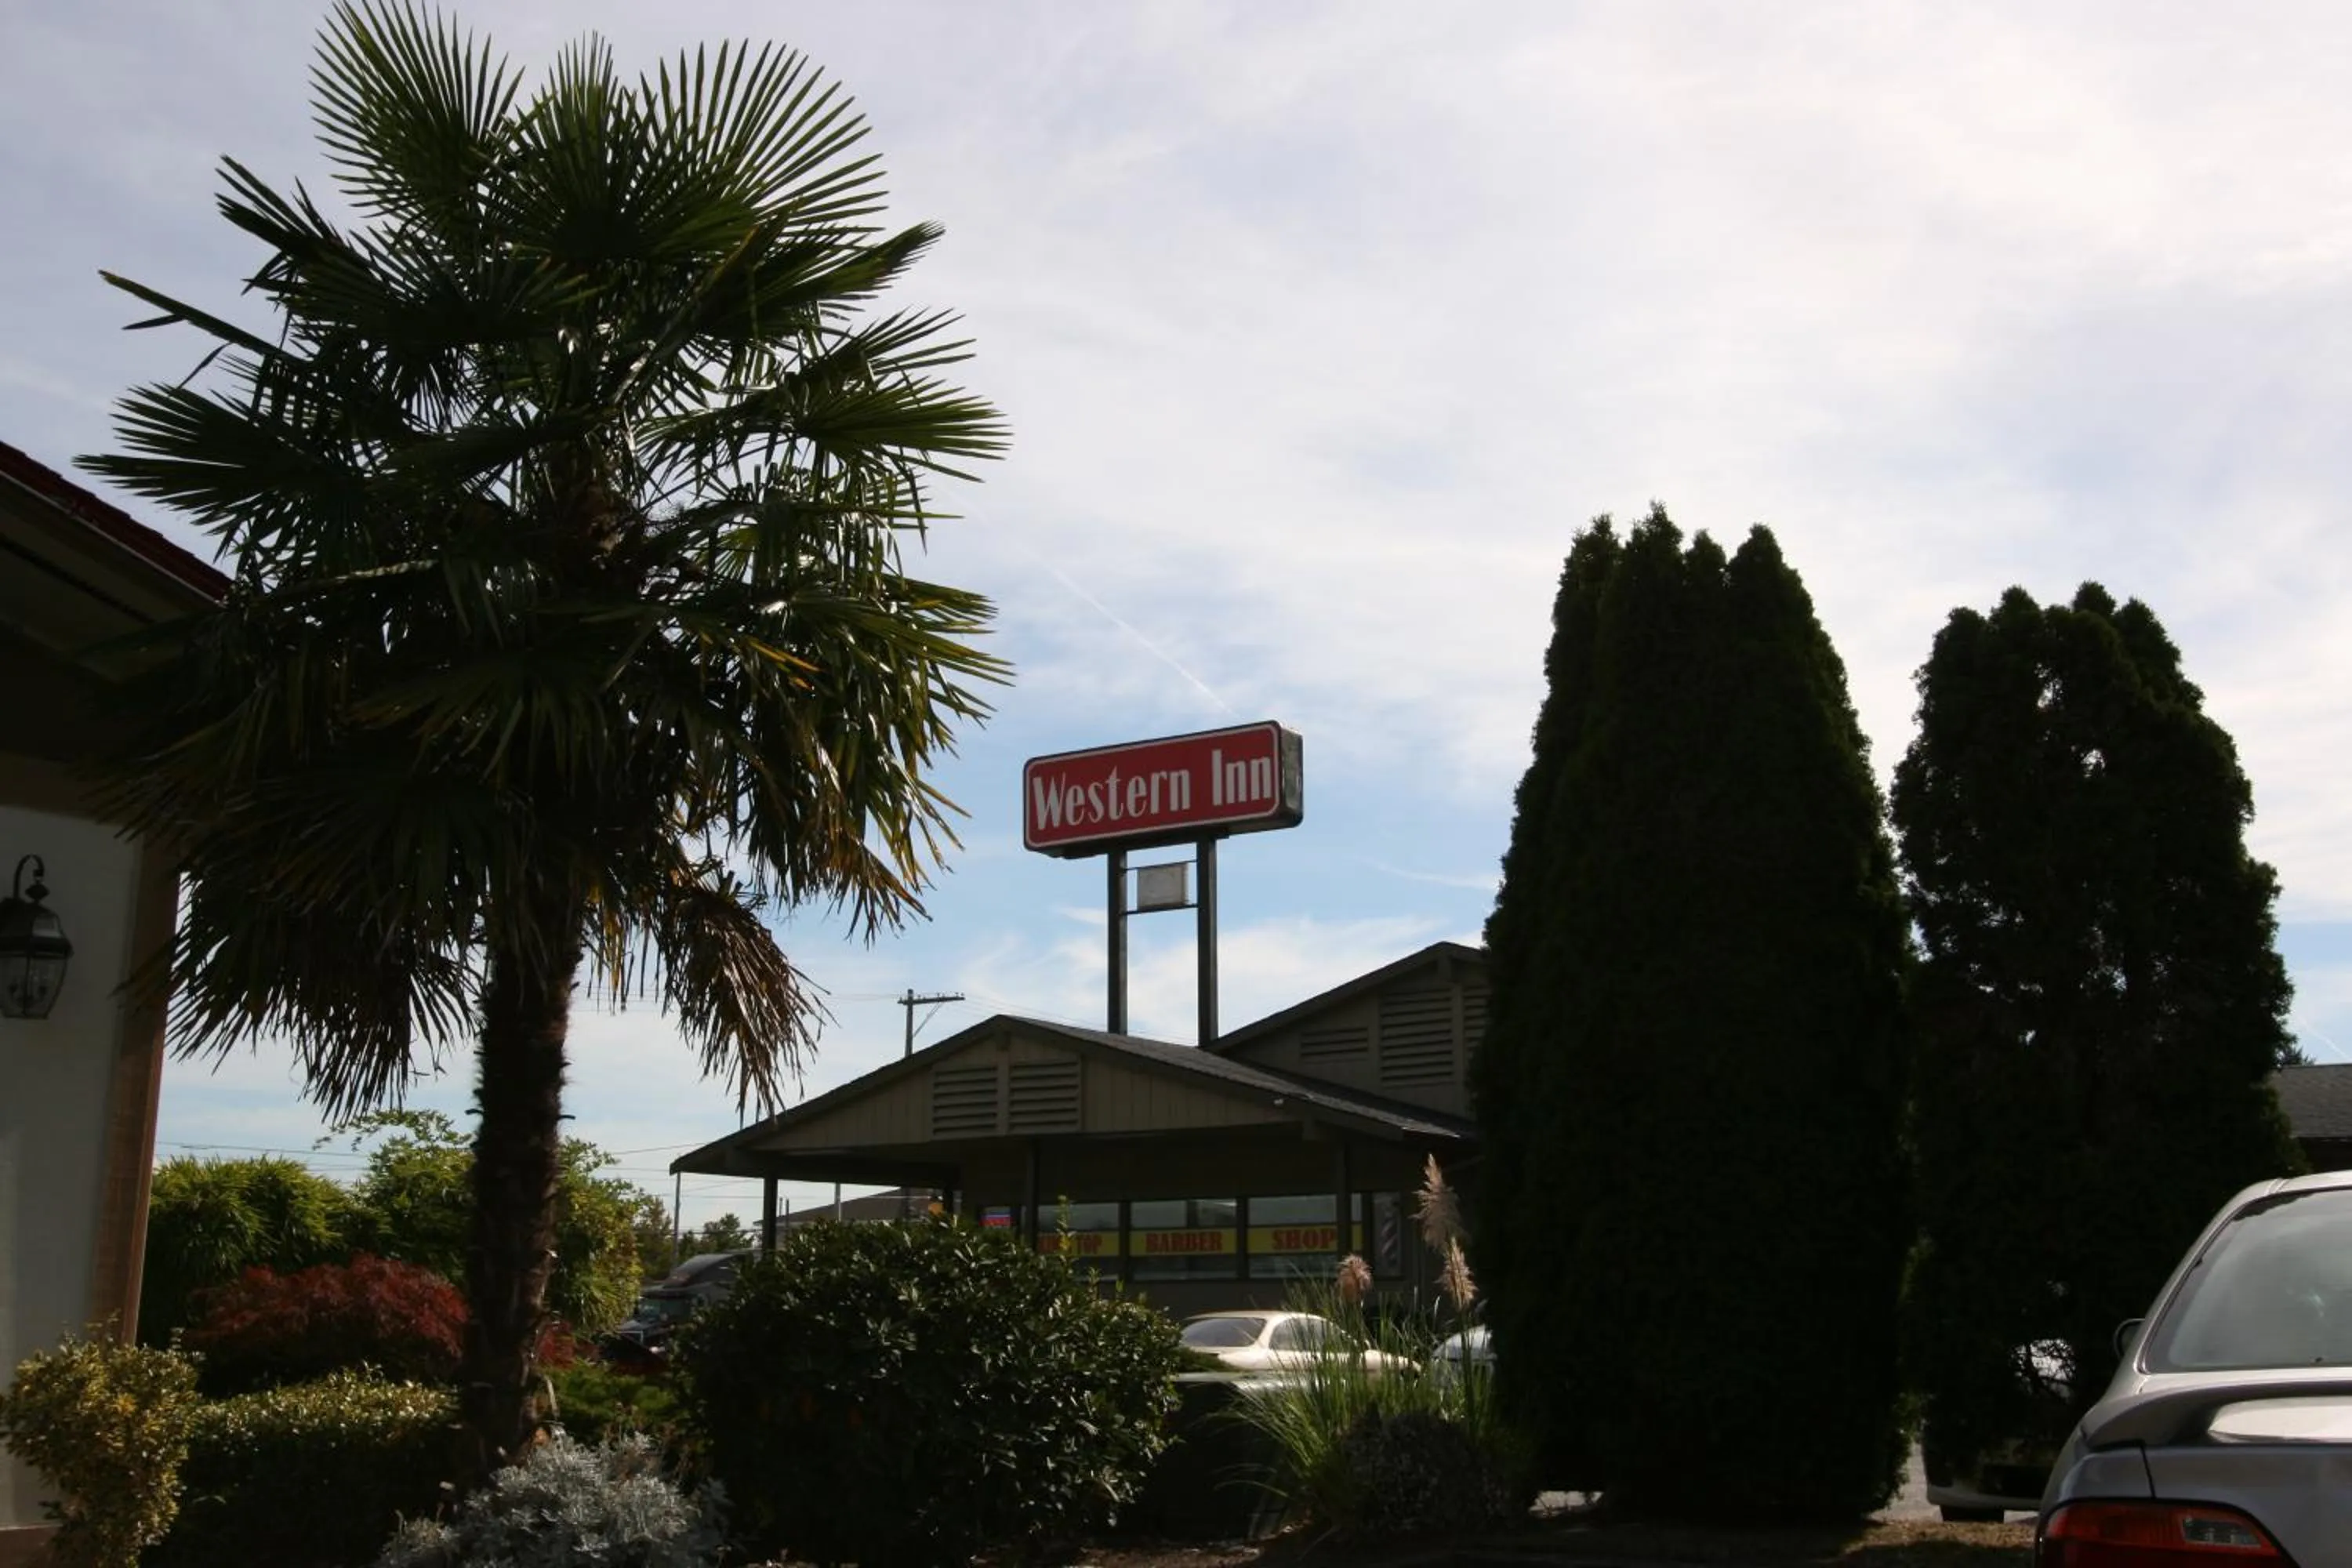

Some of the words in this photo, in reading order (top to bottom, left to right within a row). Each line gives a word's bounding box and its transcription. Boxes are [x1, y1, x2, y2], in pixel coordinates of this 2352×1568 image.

[1033, 765, 1191, 830] Western
[1212, 749, 1271, 806] Inn
[1145, 1231, 1223, 1252] BARBER
[1272, 1229, 1335, 1250] SHOP
